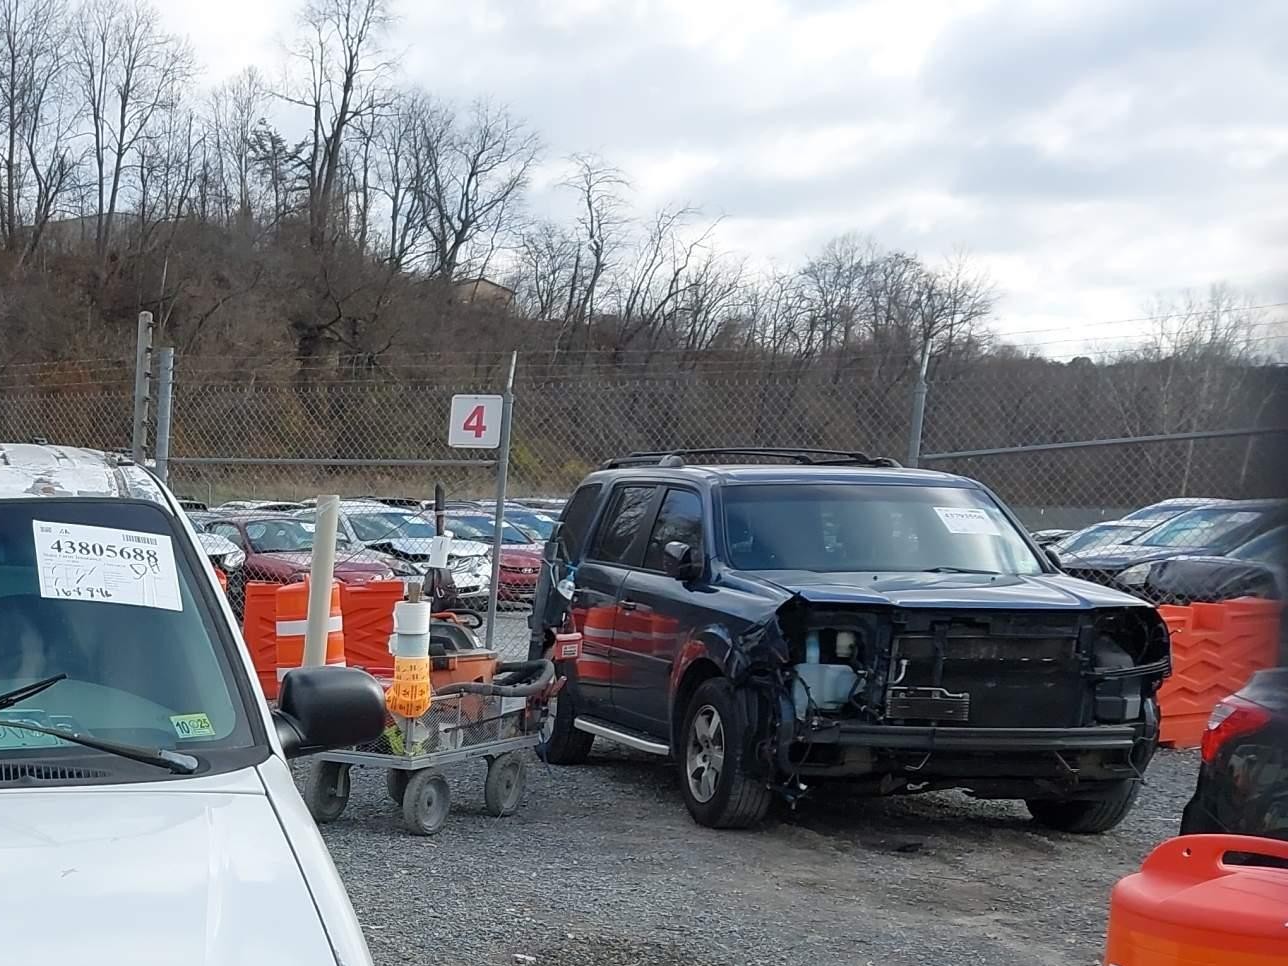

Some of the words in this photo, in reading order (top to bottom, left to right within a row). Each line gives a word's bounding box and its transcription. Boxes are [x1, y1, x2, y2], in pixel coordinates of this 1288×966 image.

[463, 405, 487, 438] 4
[50, 540, 159, 563] 43805688
[175, 720, 191, 734] 10
[197, 718, 210, 729] 25
